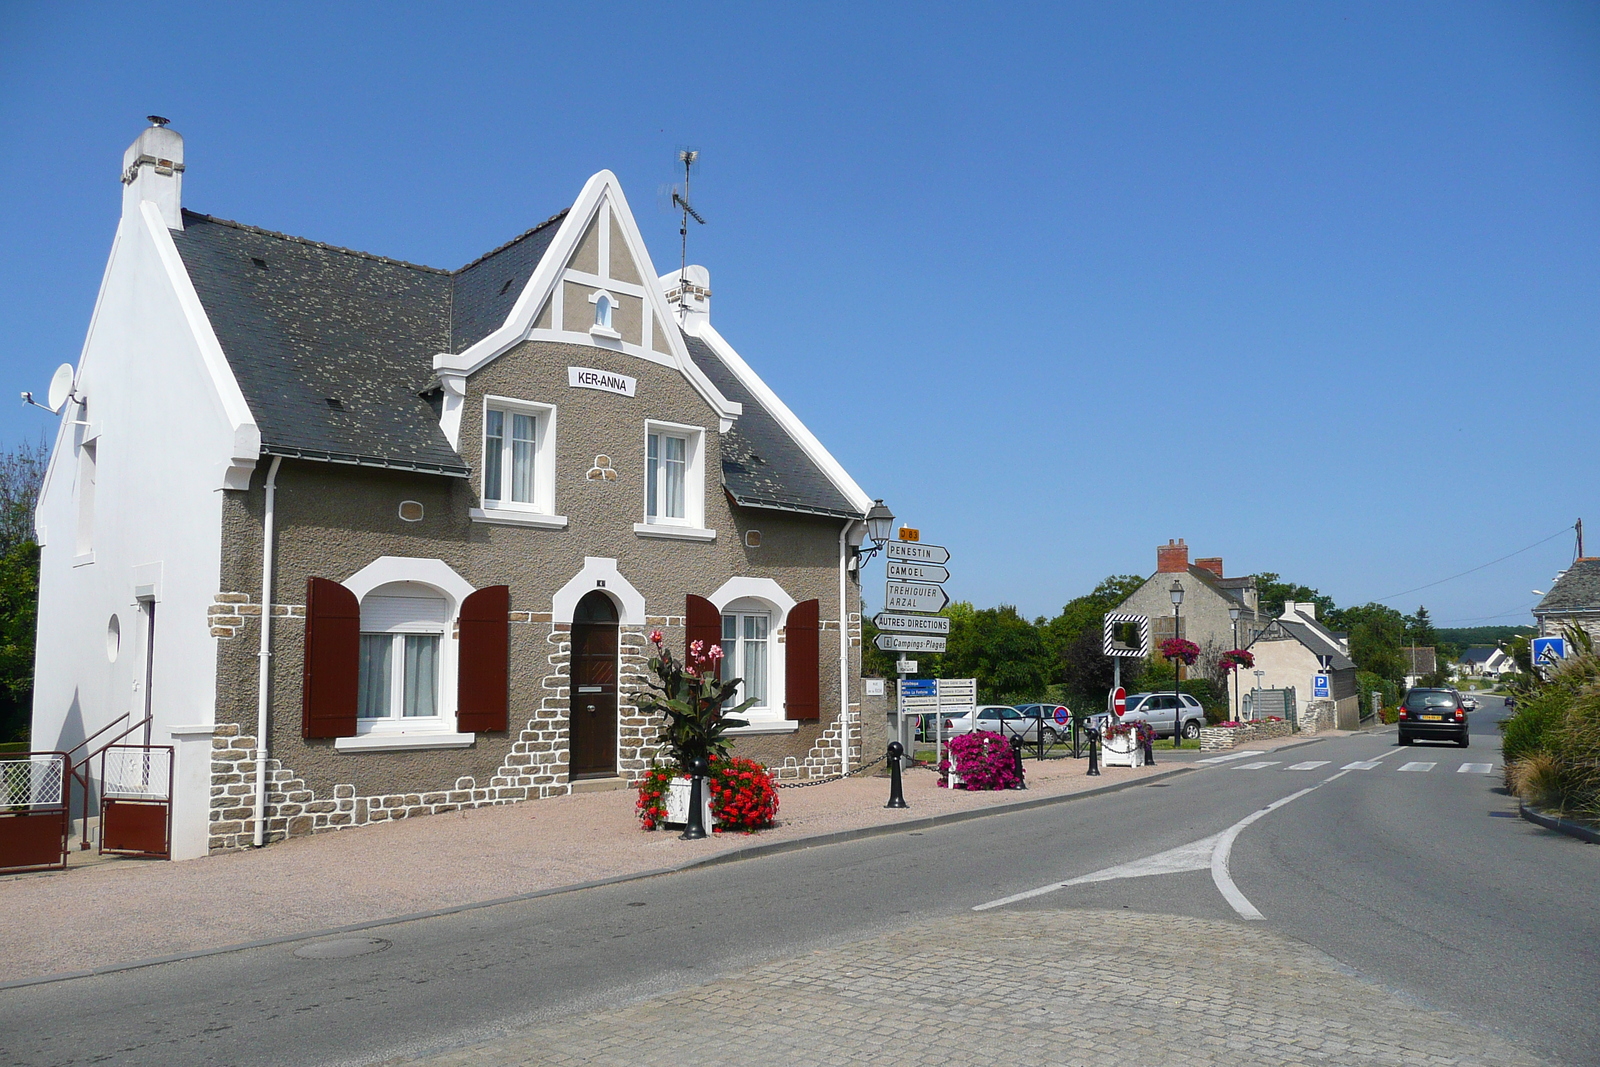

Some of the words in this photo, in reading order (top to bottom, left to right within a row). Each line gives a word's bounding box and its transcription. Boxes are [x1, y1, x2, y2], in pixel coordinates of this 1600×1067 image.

[578, 371, 627, 392] KER-ANNA
[900, 529, 906, 538] D
[908, 530, 918, 539] 83
[890, 545, 931, 558] PENESTIN
[890, 566, 924, 577] CAMOEL
[889, 585, 937, 597] TREHIGUIER
[889, 597, 917, 607] ARZAL
[878, 617, 905, 627] AUTRES
[907, 619, 947, 630] DIRECTIONS
[1317, 677, 1325, 687] P
